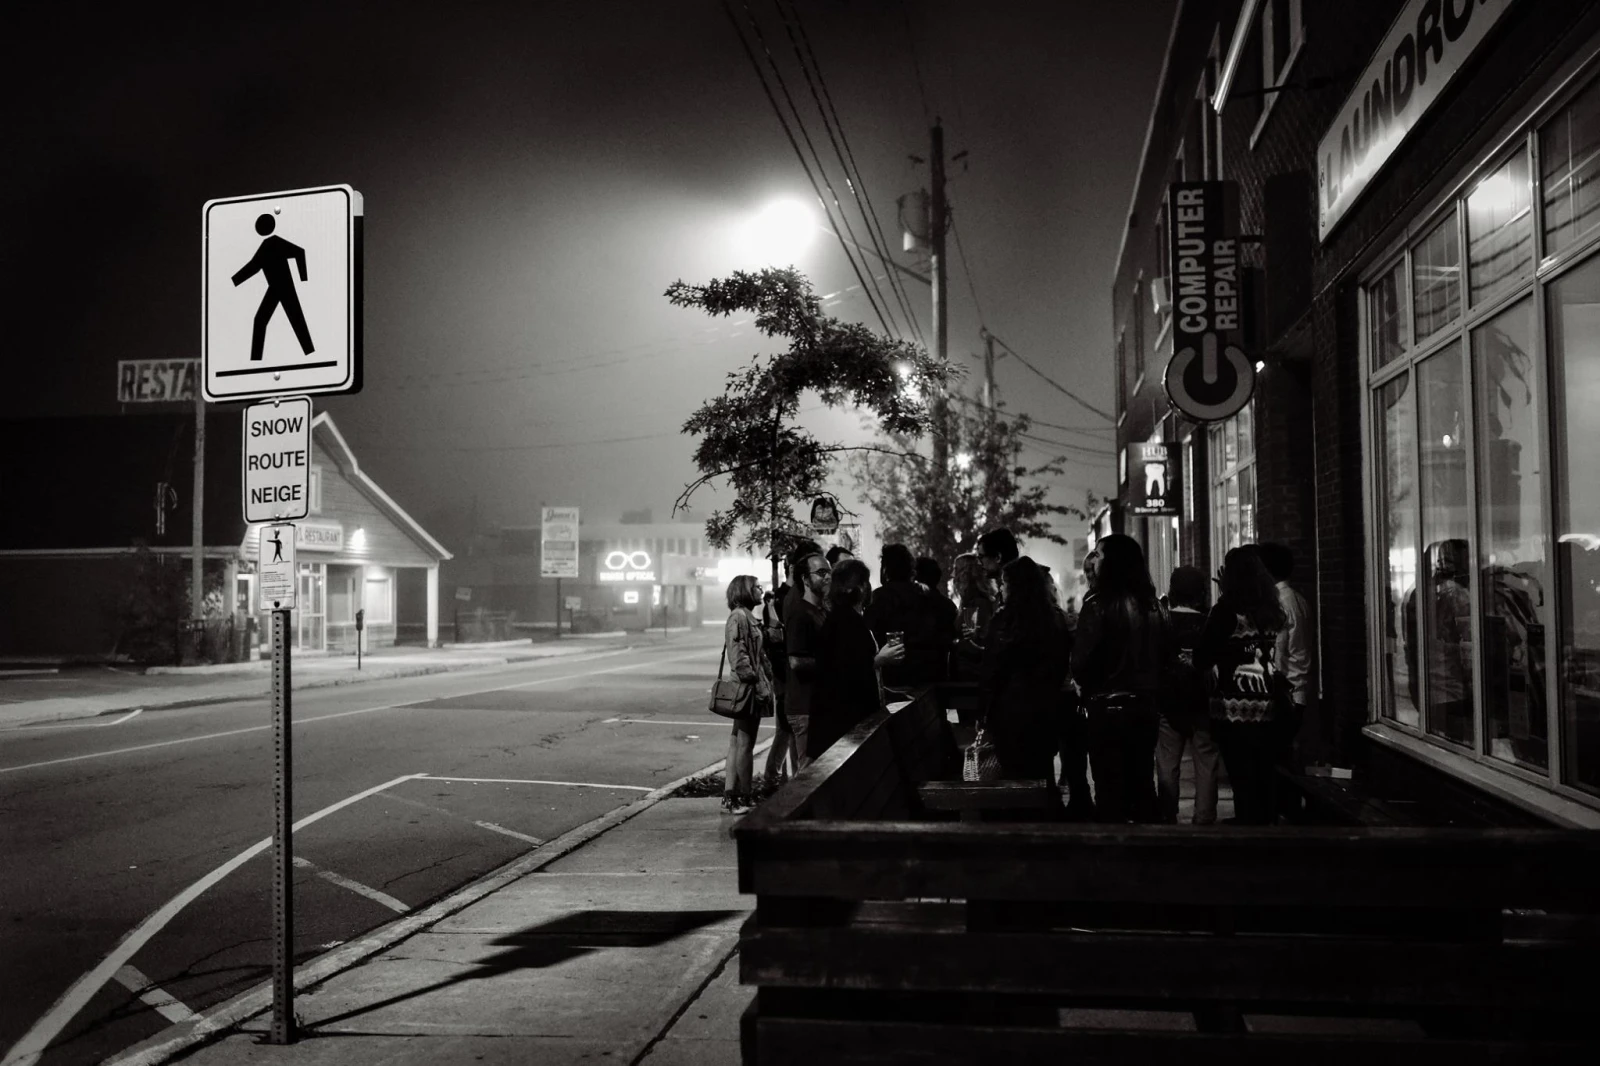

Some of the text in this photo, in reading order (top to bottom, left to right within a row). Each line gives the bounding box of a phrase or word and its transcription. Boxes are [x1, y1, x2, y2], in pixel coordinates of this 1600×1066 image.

[1326, 0, 1488, 209] LAUNDRO
[1177, 188, 1208, 334] COMPUTER
[1213, 239, 1238, 330] REPAIR
[251, 416, 303, 437] SNOW
[248, 450, 305, 471] ROUTE
[251, 484, 302, 504] NEIGE
[1146, 499, 1165, 507] 380
